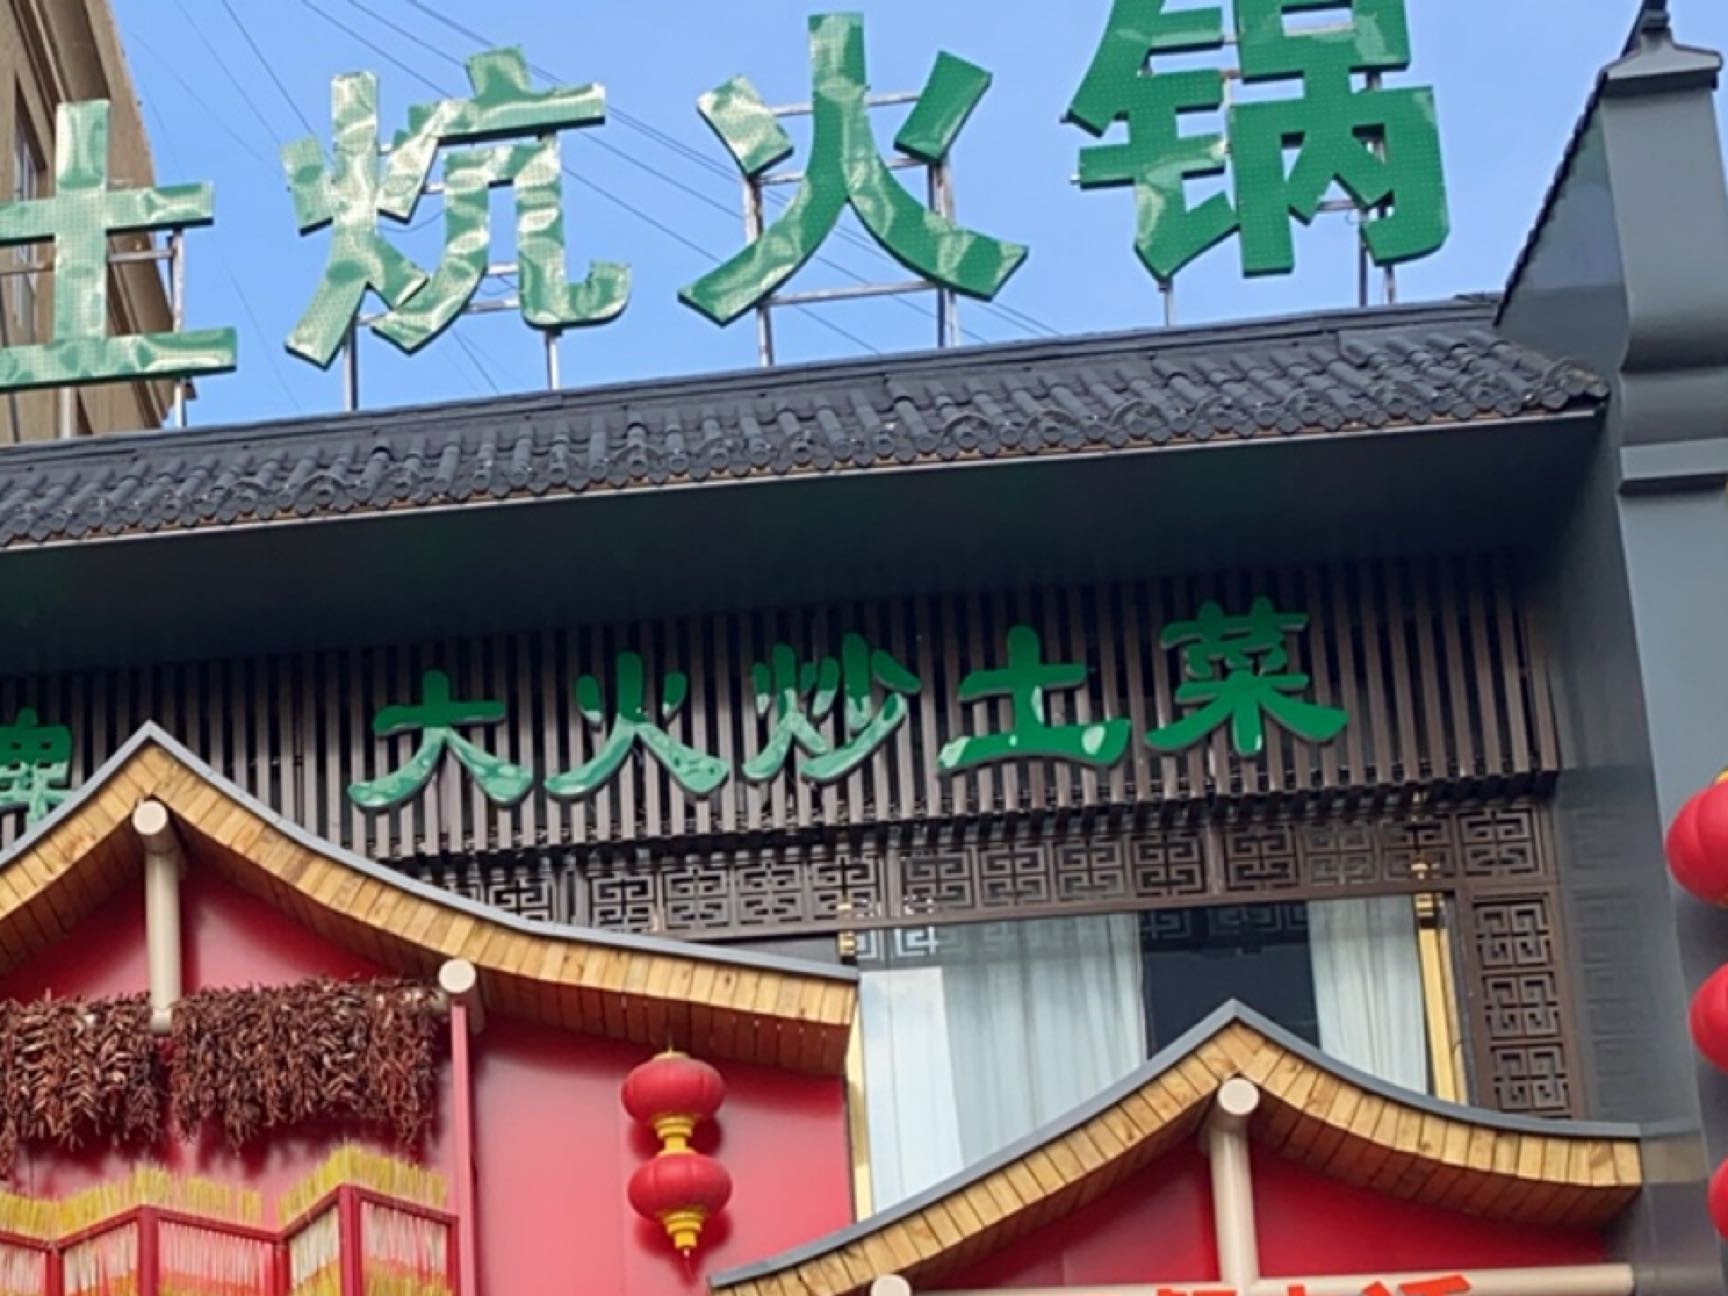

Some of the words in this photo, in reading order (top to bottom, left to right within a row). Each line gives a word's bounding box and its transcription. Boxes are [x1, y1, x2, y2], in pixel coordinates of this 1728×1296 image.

[348, 597, 1350, 809] 大火炒土菜
